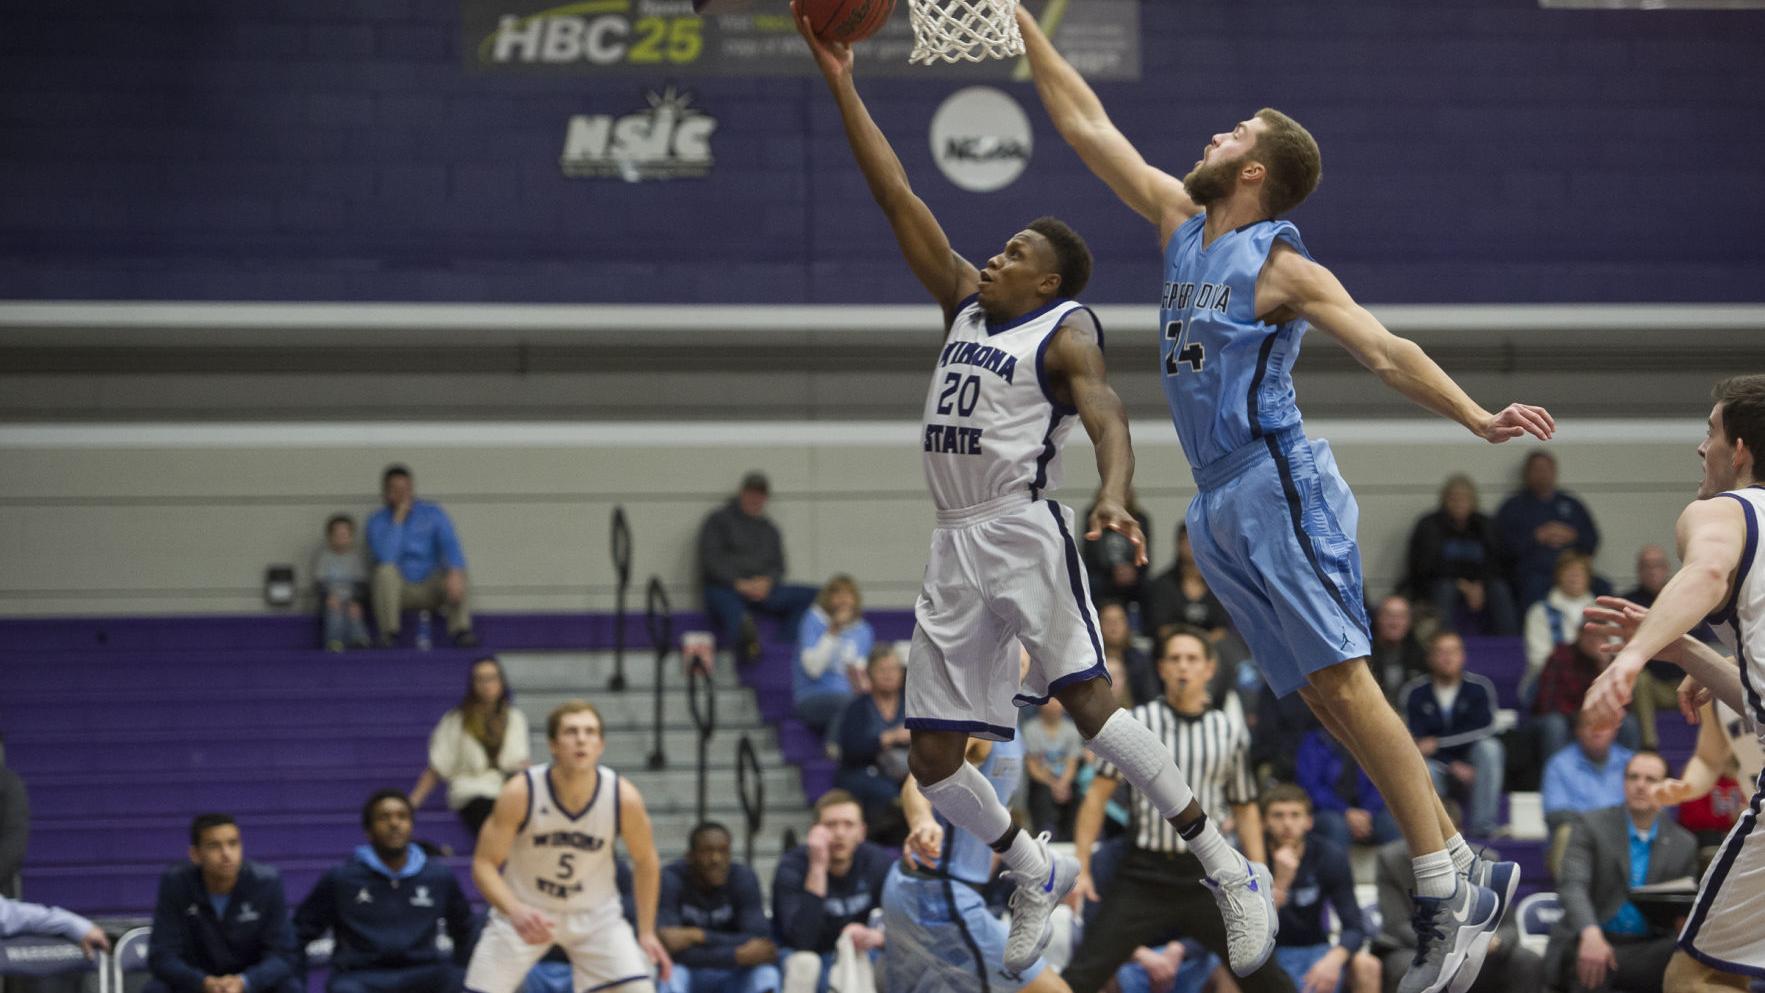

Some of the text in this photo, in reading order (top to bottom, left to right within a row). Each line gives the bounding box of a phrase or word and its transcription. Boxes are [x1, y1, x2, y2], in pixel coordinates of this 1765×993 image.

[1166, 320, 1205, 376] 24
[936, 371, 981, 418] 20
[923, 423, 984, 456] STATE
[556, 853, 576, 880] 5
